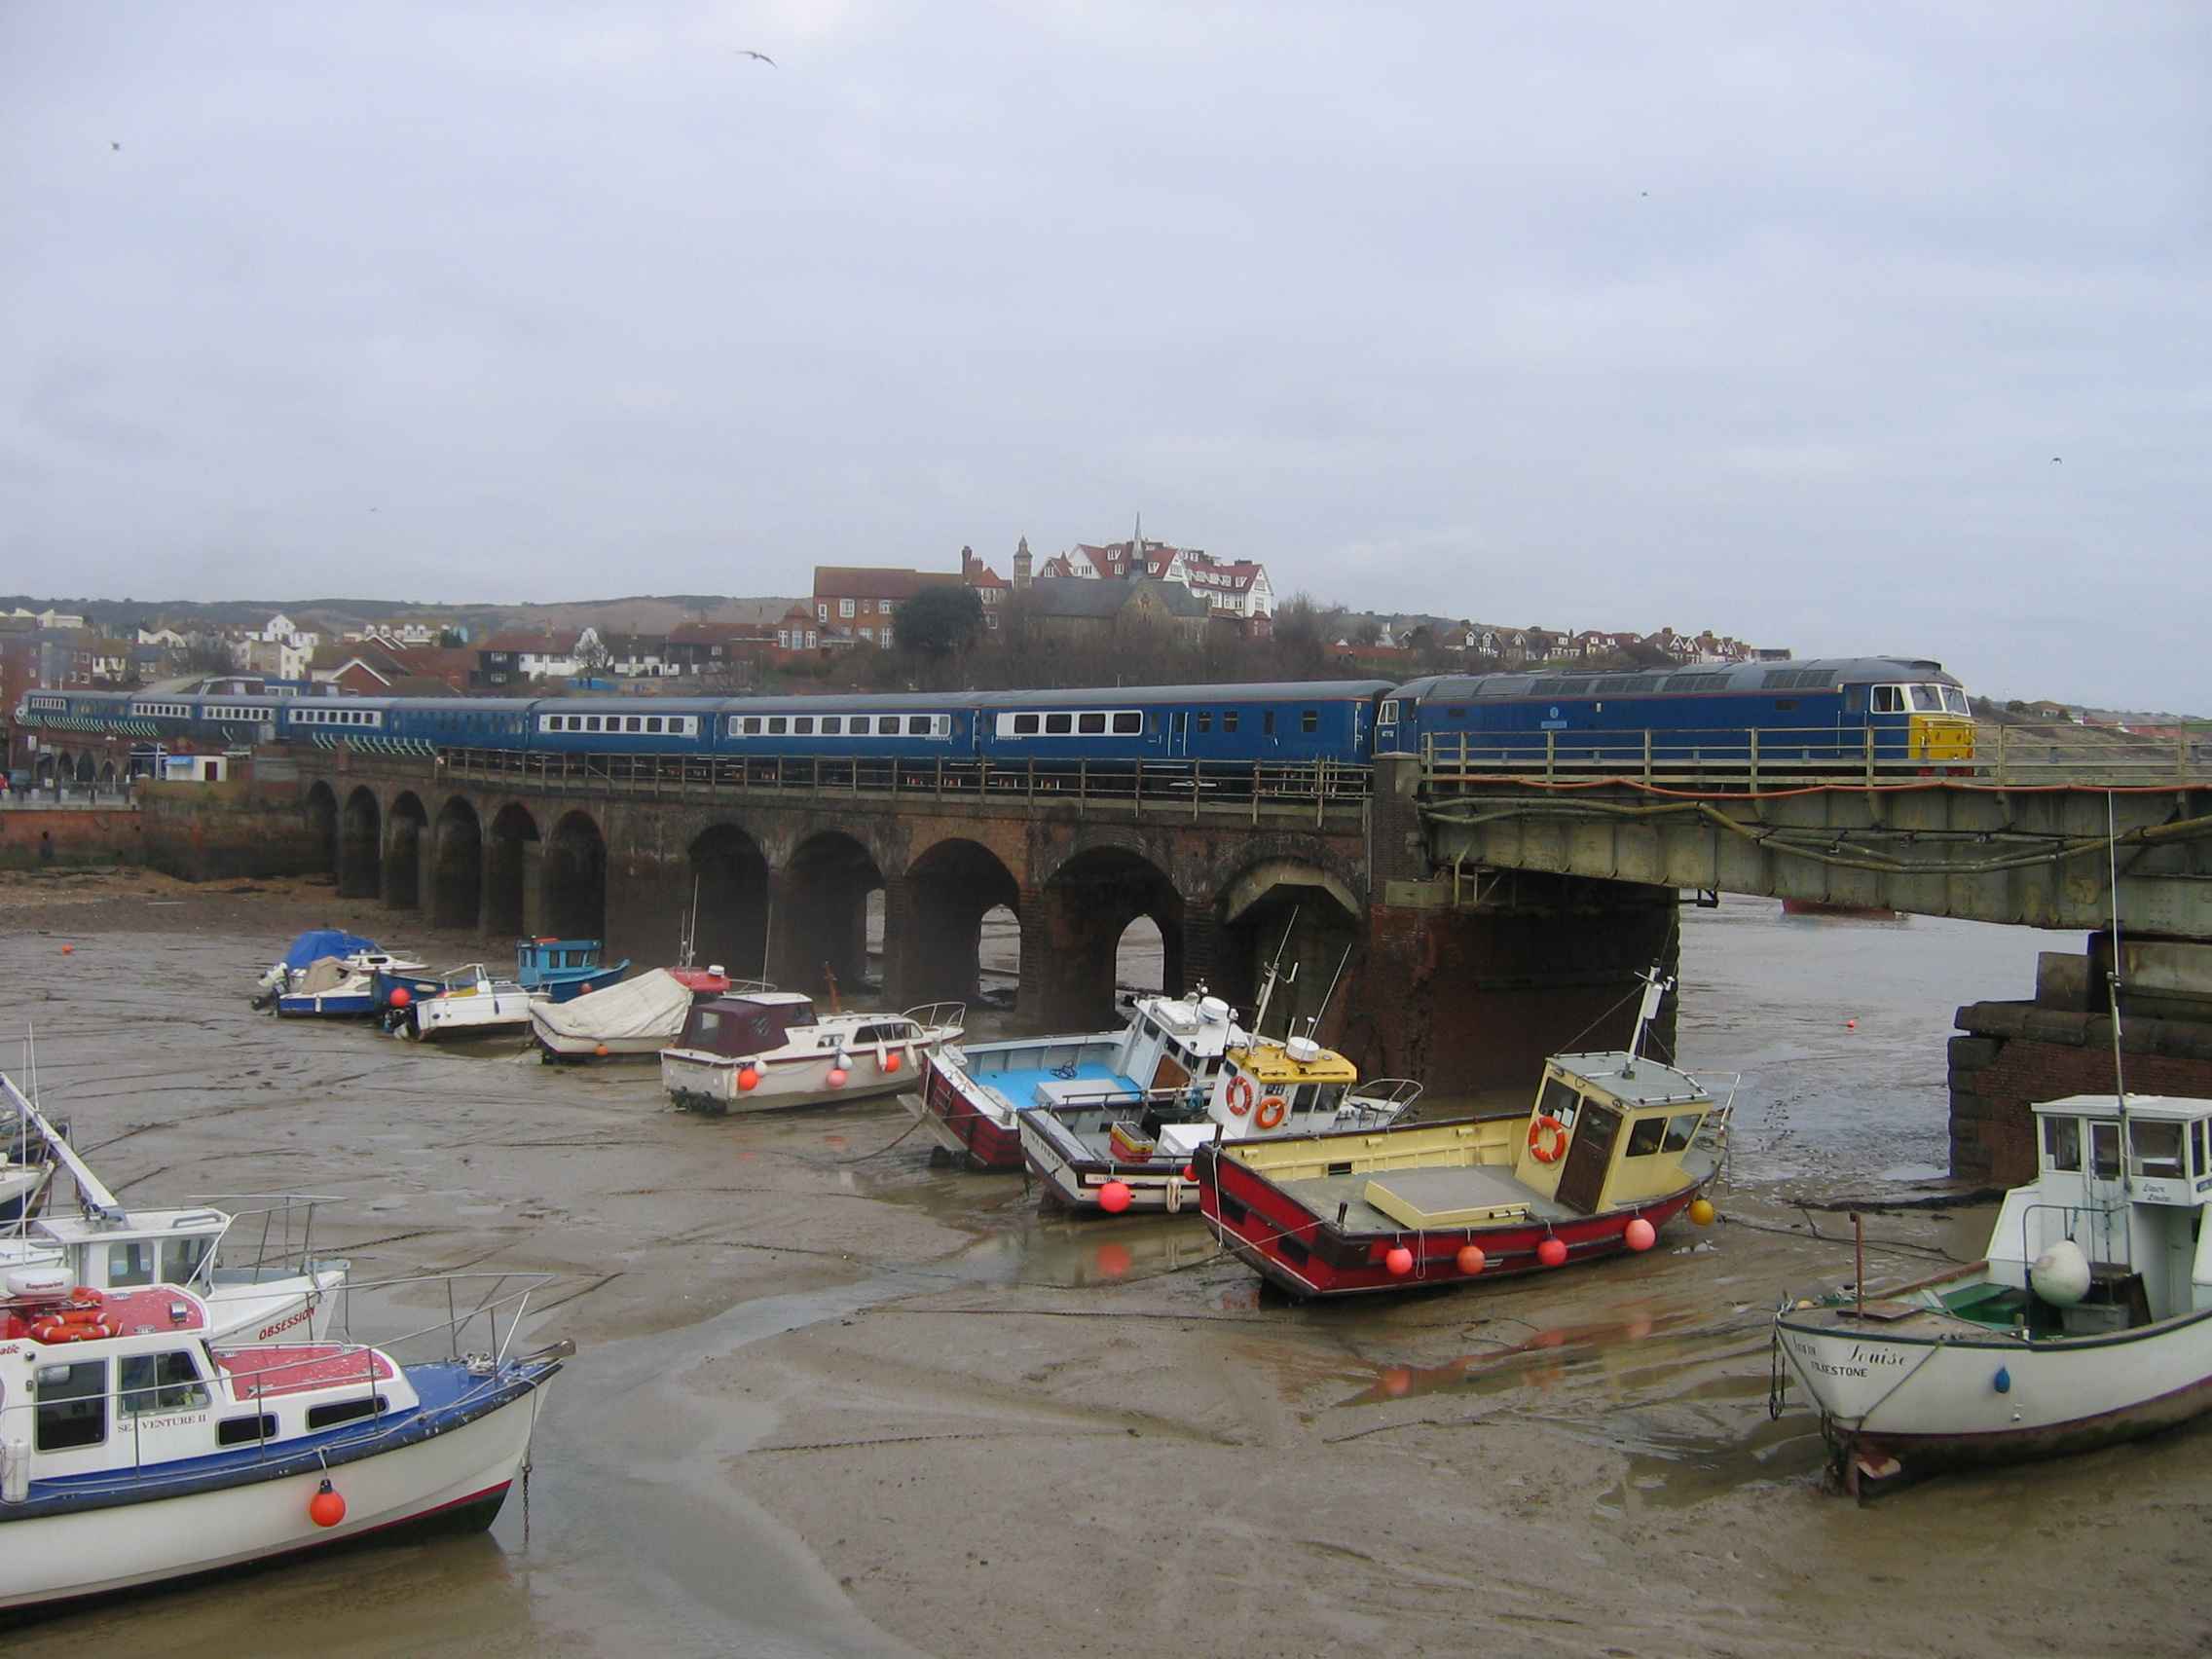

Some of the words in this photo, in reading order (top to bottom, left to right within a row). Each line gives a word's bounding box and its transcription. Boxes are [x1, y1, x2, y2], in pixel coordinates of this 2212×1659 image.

[259, 1307, 315, 1341] OBSESSION
[118, 1422, 137, 1434] SE
[141, 1416, 196, 1429] VENTURE
